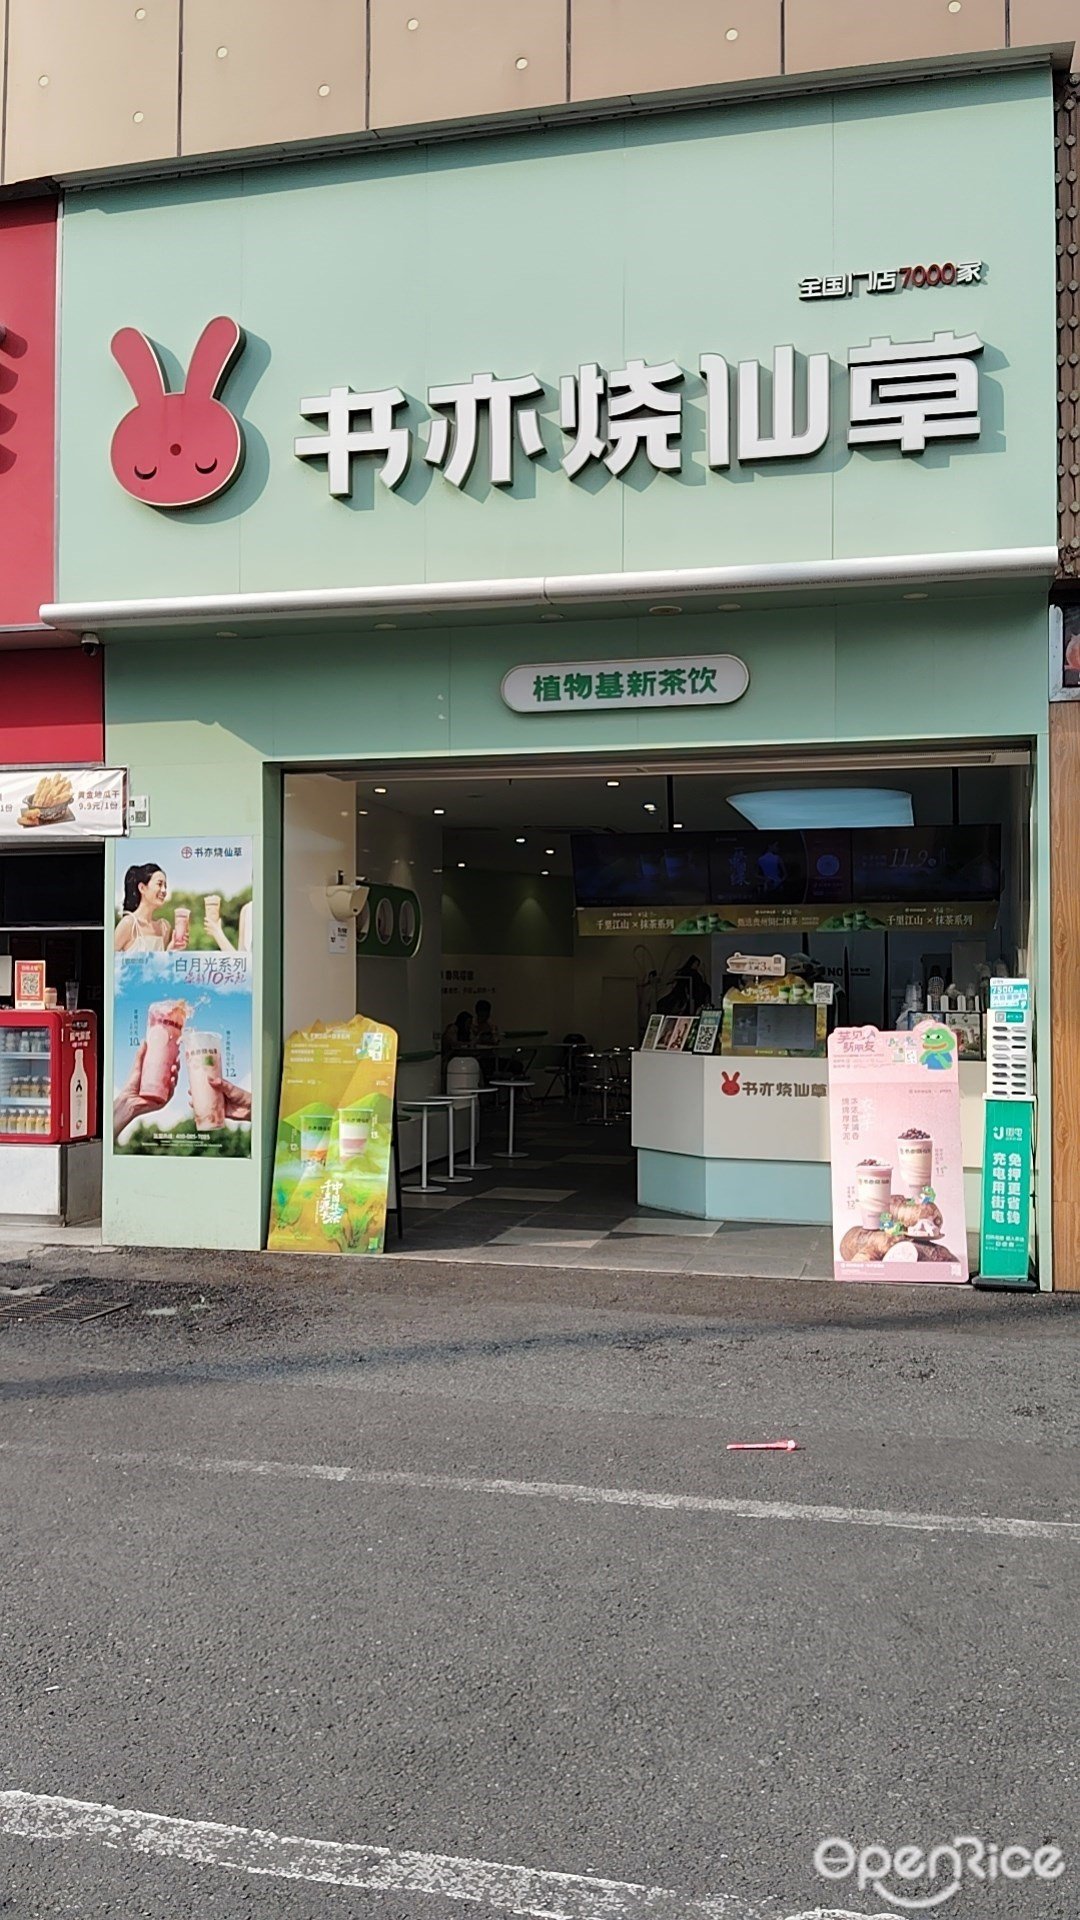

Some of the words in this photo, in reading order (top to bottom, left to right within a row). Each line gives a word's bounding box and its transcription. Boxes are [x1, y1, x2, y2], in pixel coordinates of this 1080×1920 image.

[800, 261, 982, 300] 全国门店7000家
[293, 331, 984, 498] 书亦烧仙草
[533, 667, 718, 702] 植物基新茶饮
[78, 790, 120, 799] 黄金地瓜干
[79, 801, 118, 810] 9.9元/1份
[194, 847, 243, 857] 书亦烧仙草
[175, 957, 247, 972] 白月光系列
[742, 1082, 827, 1098] 书亦烧仙草
[991, 1152, 1006, 1224] 充电用街电
[1007, 1153, 1021, 1225] 免押更省钱
